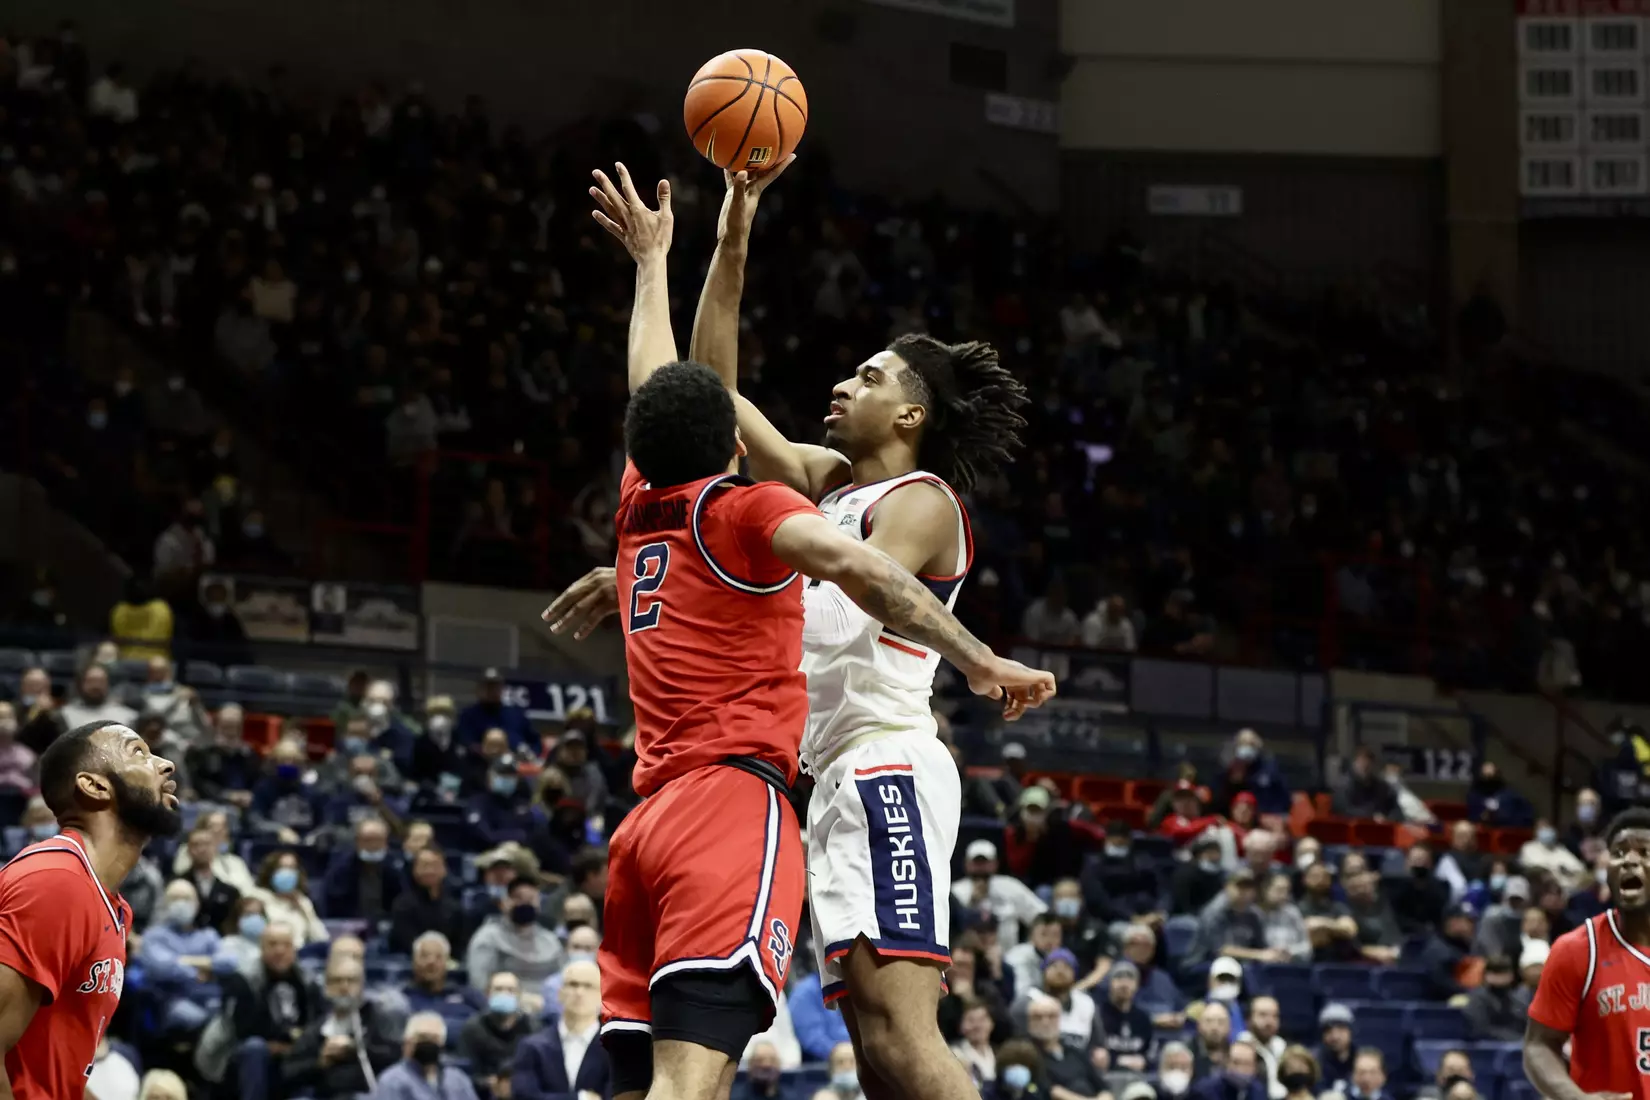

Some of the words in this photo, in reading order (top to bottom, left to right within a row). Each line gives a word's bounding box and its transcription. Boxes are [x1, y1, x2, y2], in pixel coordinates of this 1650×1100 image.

[629, 542, 670, 634] 2
[545, 682, 610, 723] 121
[1423, 747, 1474, 782] 122
[878, 784, 921, 930] HUSKIES
